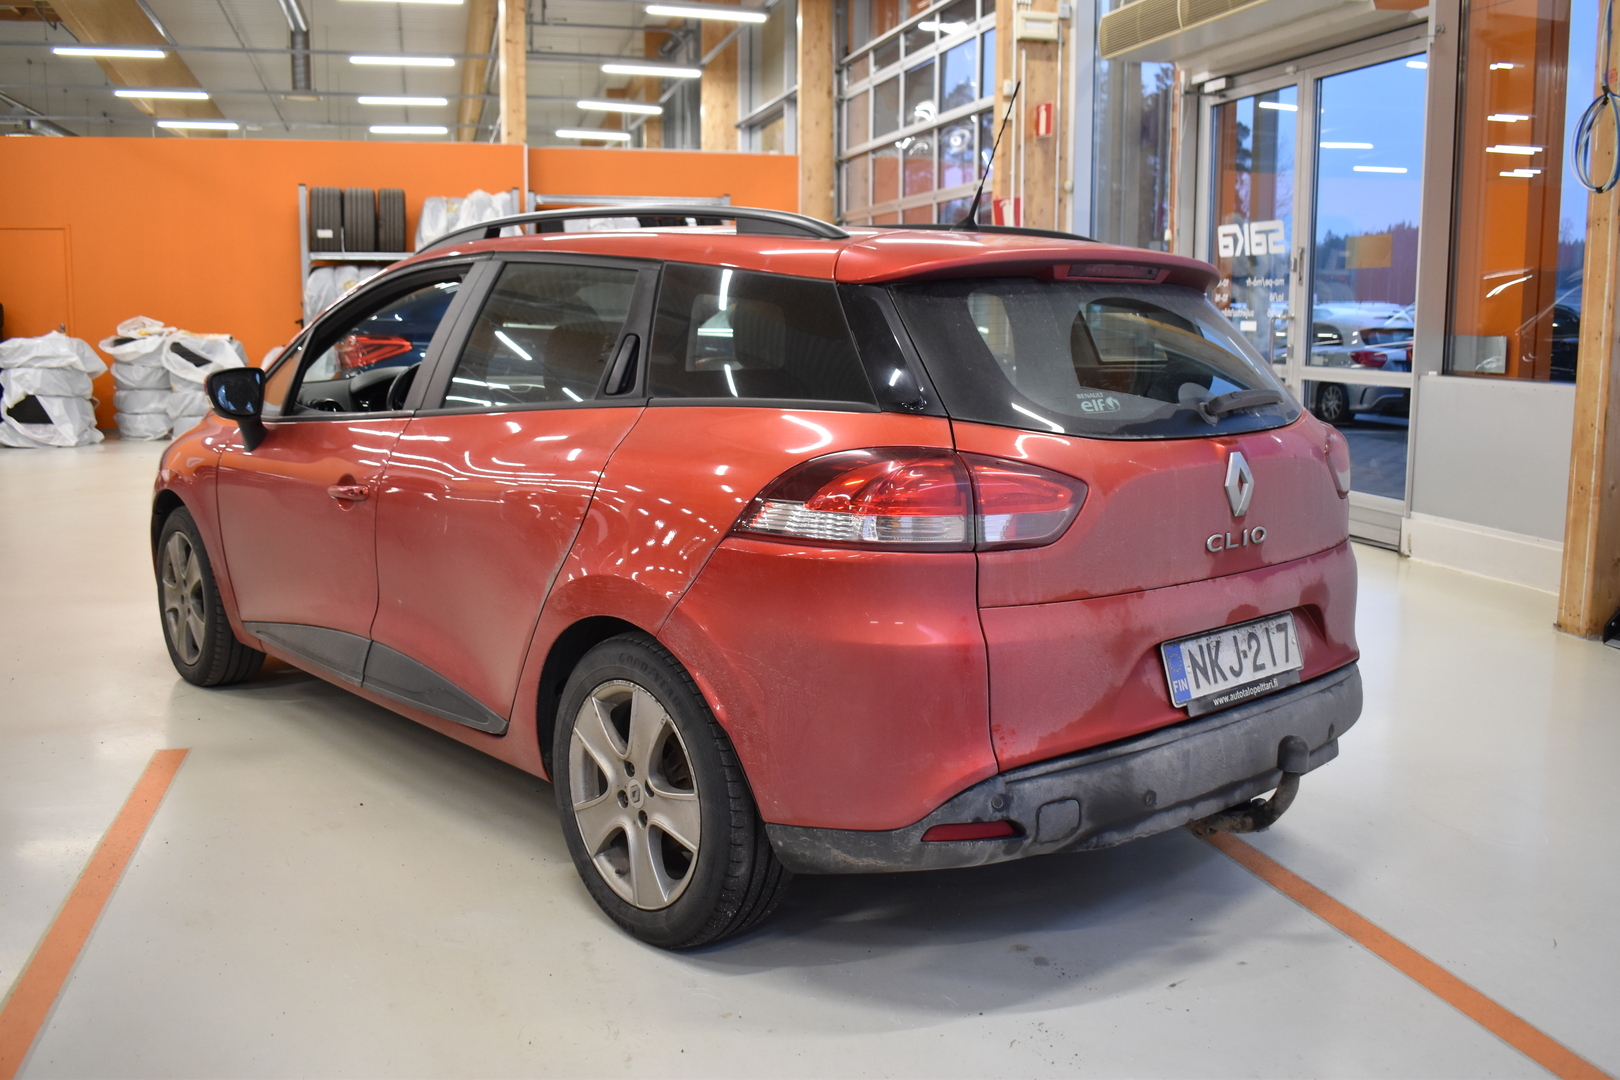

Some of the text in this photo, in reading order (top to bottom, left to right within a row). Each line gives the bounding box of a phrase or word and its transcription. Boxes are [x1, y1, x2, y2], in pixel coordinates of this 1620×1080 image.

[1080, 399, 1105, 412] elf
[1205, 525, 1268, 553] CLIO
[1187, 622, 1290, 690] NKJ-217
[1172, 678, 1189, 693] FIN
[1213, 678, 1279, 706] www.autotalopelttari.fi
